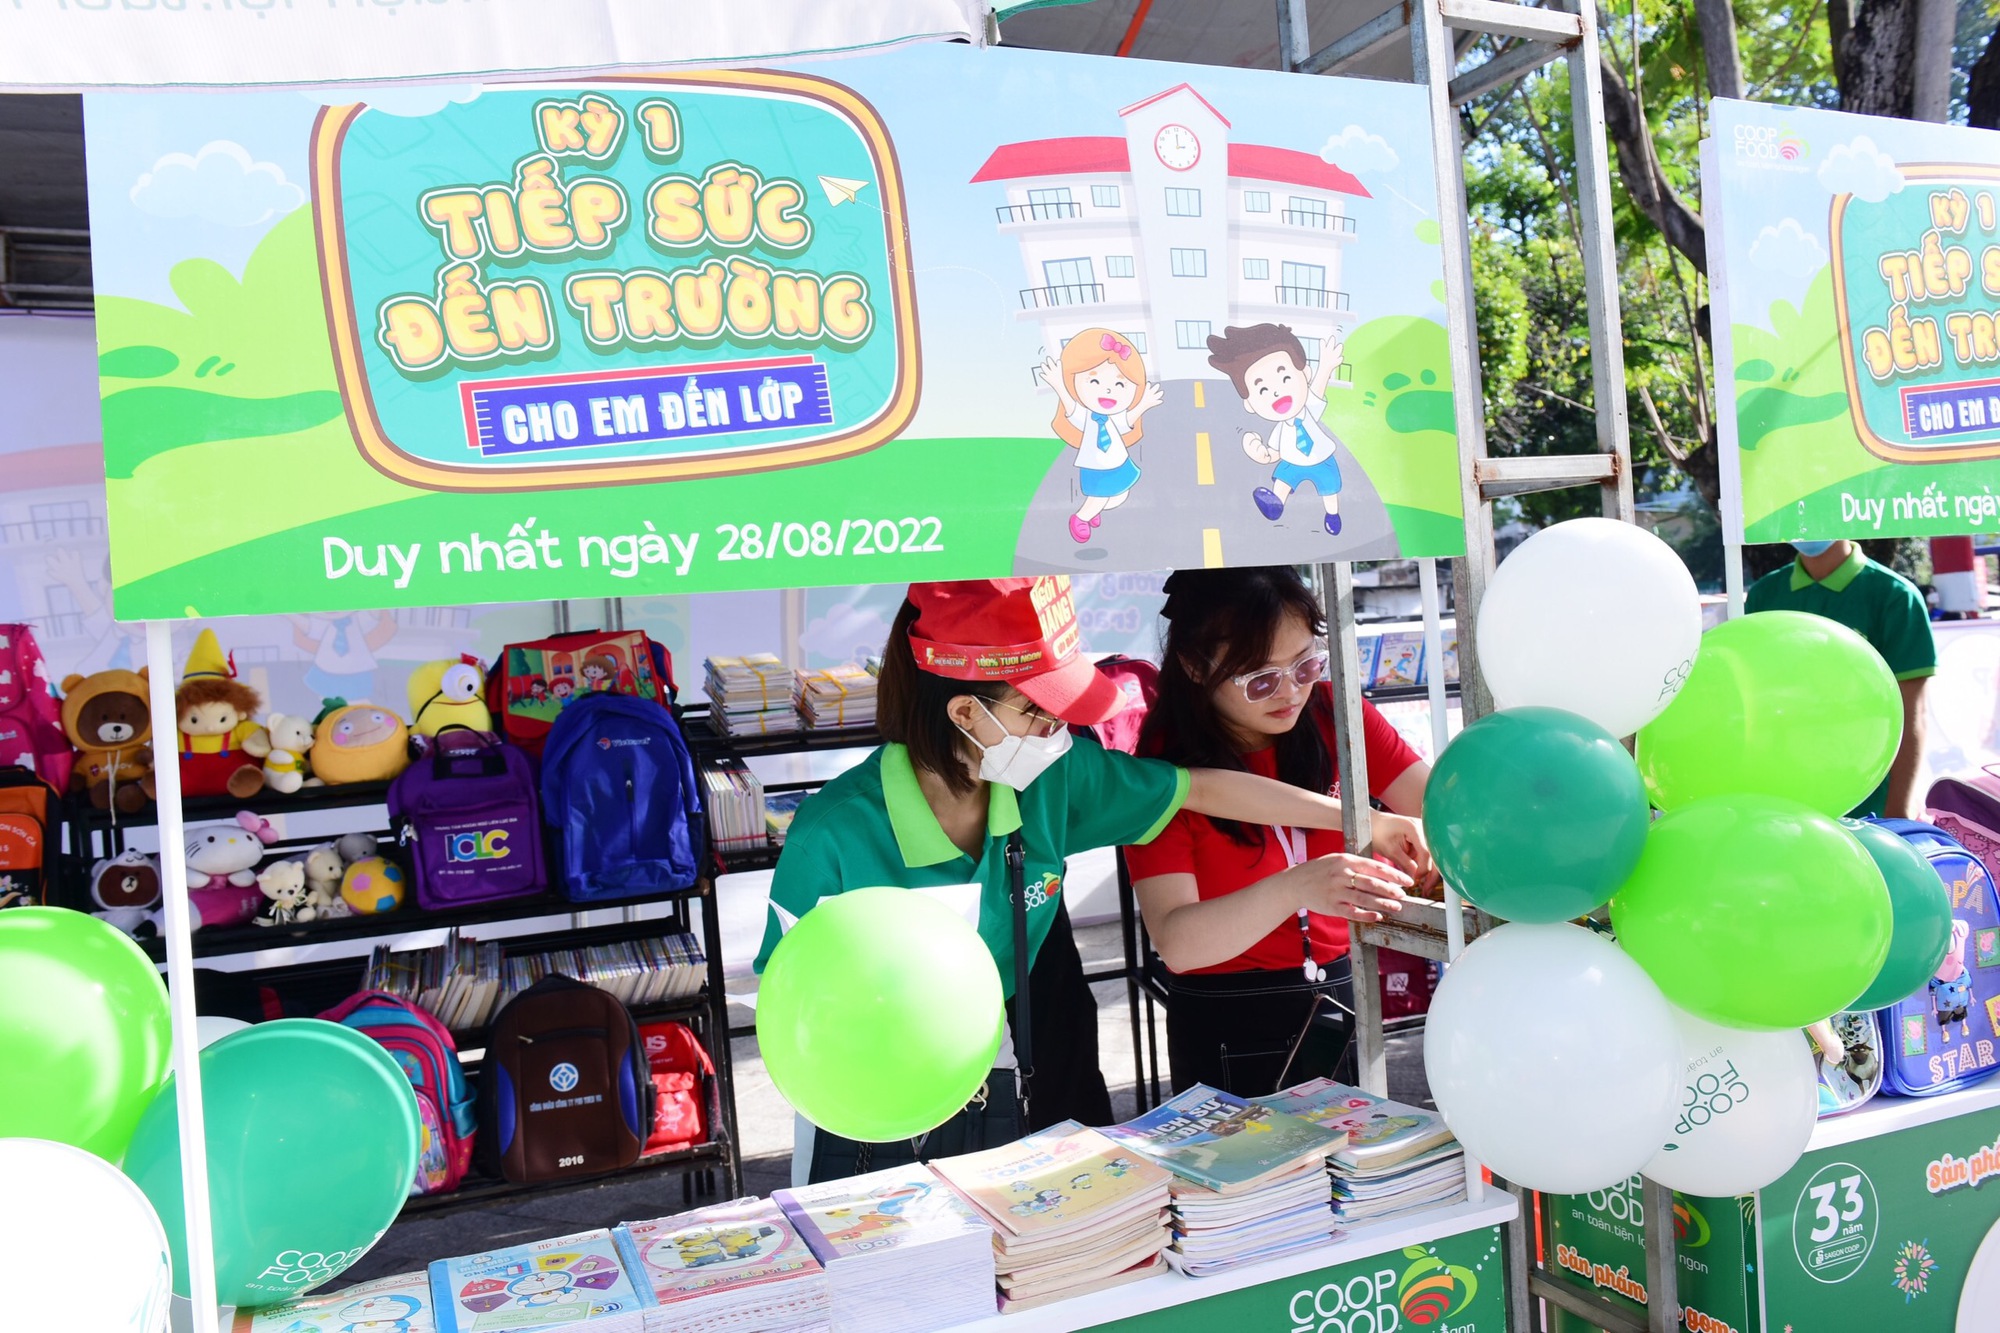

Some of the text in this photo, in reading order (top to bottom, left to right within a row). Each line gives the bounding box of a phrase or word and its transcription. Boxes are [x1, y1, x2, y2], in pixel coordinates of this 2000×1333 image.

[639, 100, 680, 155] 1
[1735, 140, 1779, 159] FOOD
[422, 155, 811, 259] TIẾP SỨC
[1976, 192, 1995, 230] 1
[1880, 229, 1973, 303] TIẾP
[379, 258, 871, 372] ĐẾN TRƯỜNG
[1863, 303, 1941, 379] ĐẾN
[501, 376, 803, 445] CHO EM ĐẾN LỚP
[1919, 402, 1955, 432] CHO
[1958, 398, 1986, 427] EM
[1841, 492, 1885, 530] Duy
[1892, 481, 1949, 520] nhất
[322, 516, 945, 589] Duy nhất ngày 28/08/2022
[445, 829, 511, 863] ICLC
[1928, 1040, 1997, 1084] STAR
[559, 1155, 585, 1168] 2016
[1928, 1155, 1968, 1191] Sản
[1572, 1208, 1585, 1221] an
[1810, 1175, 1864, 1243] 33
[1843, 1223, 1863, 1236] năm
[1557, 1243, 1648, 1304] Sản phẩm
